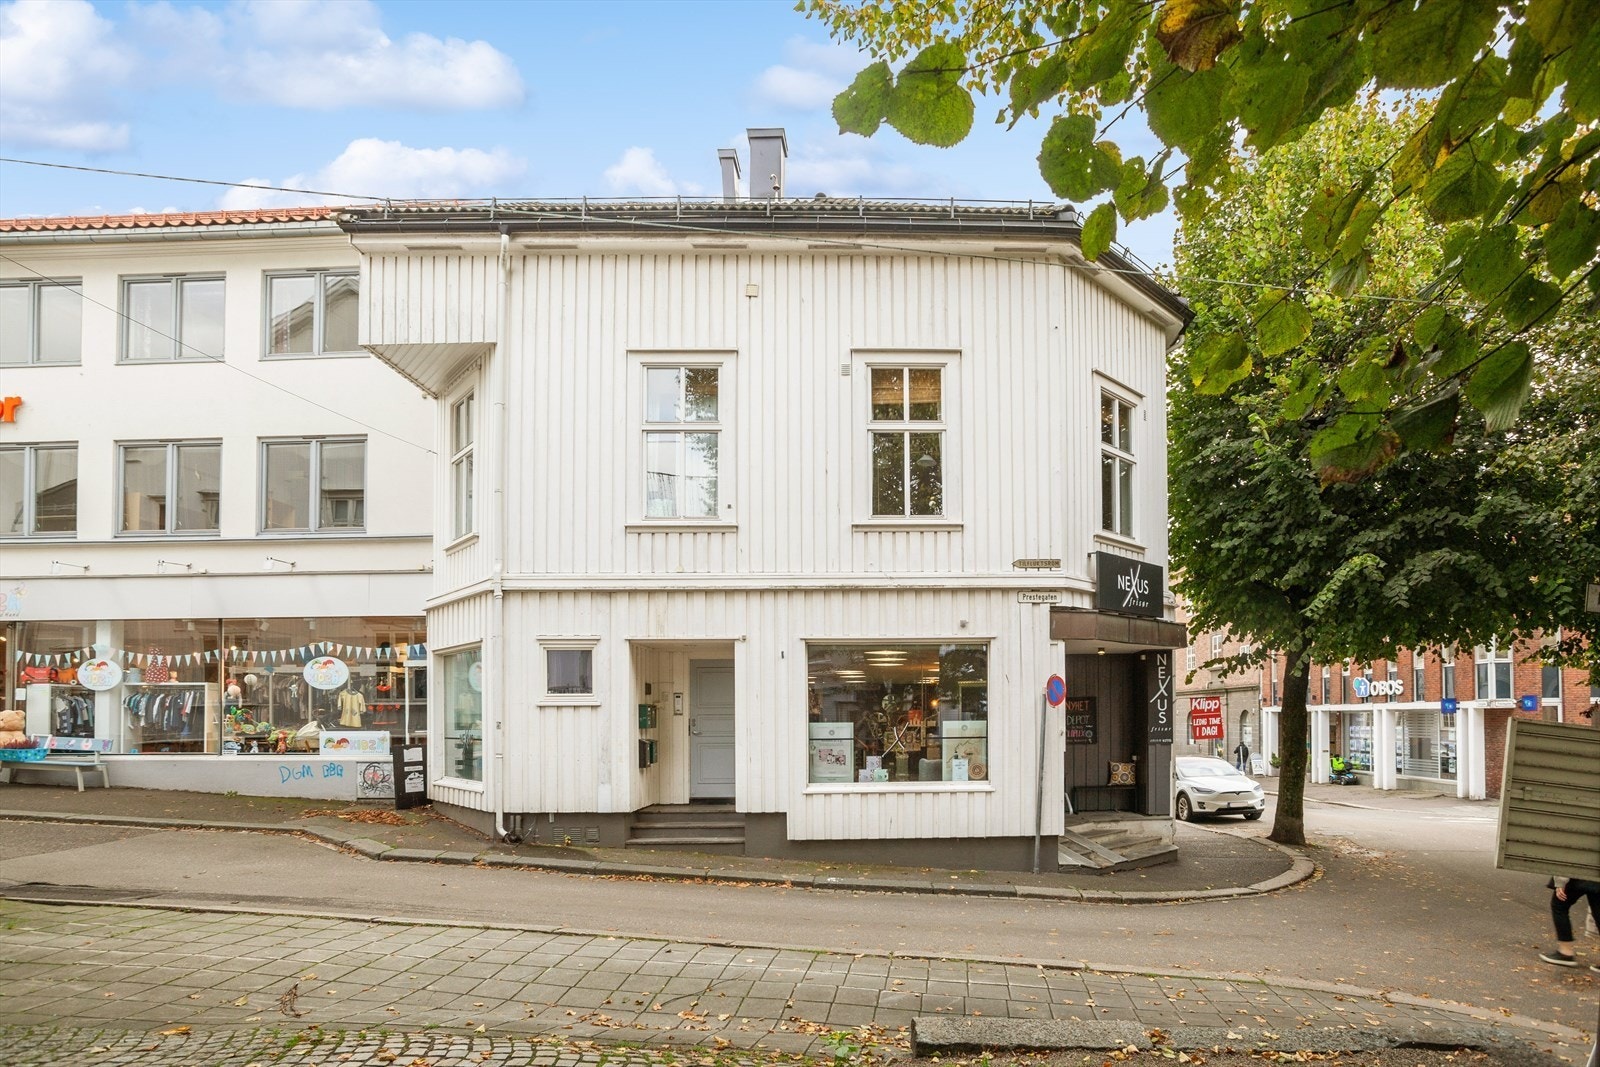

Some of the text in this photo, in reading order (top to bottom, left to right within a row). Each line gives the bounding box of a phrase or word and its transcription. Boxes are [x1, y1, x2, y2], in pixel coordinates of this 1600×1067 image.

[1117, 564, 1149, 607] NEXUS
[1022, 593, 1057, 601] Prestegaten
[1150, 653, 1171, 724] NEXUS
[1370, 679, 1404, 696] OBOS
[1191, 698, 1219, 712] Klipp
[1193, 717, 1221, 726] LEDIG TIME
[1196, 725, 1218, 737] I DAG!
